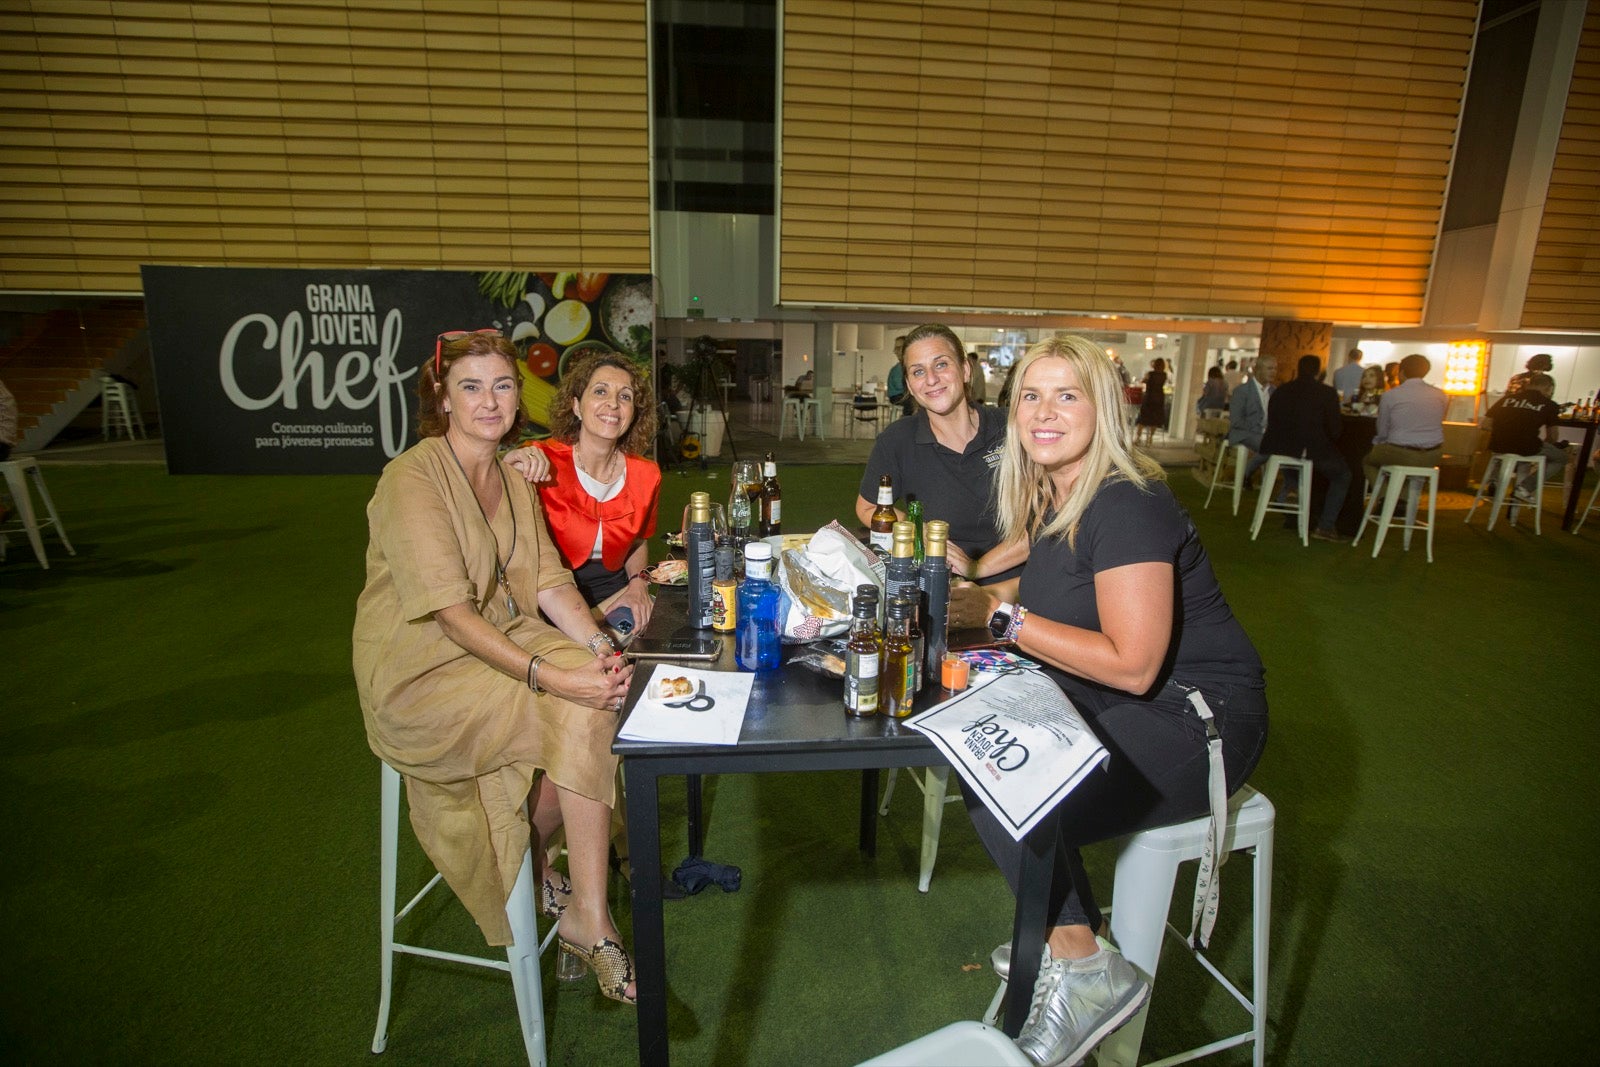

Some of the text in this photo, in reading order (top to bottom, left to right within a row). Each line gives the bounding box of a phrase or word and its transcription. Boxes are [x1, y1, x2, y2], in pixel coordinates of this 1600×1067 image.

[305, 283, 376, 313] GRANA
[310, 313, 378, 346] JOVEN
[219, 308, 419, 459] Chef
[271, 421, 374, 434] Concurso culinario
[254, 434, 375, 449] para jóvenes promesas
[961, 713, 1030, 772] Chef
[964, 736, 986, 761] GRANA
[970, 729, 995, 753] JOVEN
